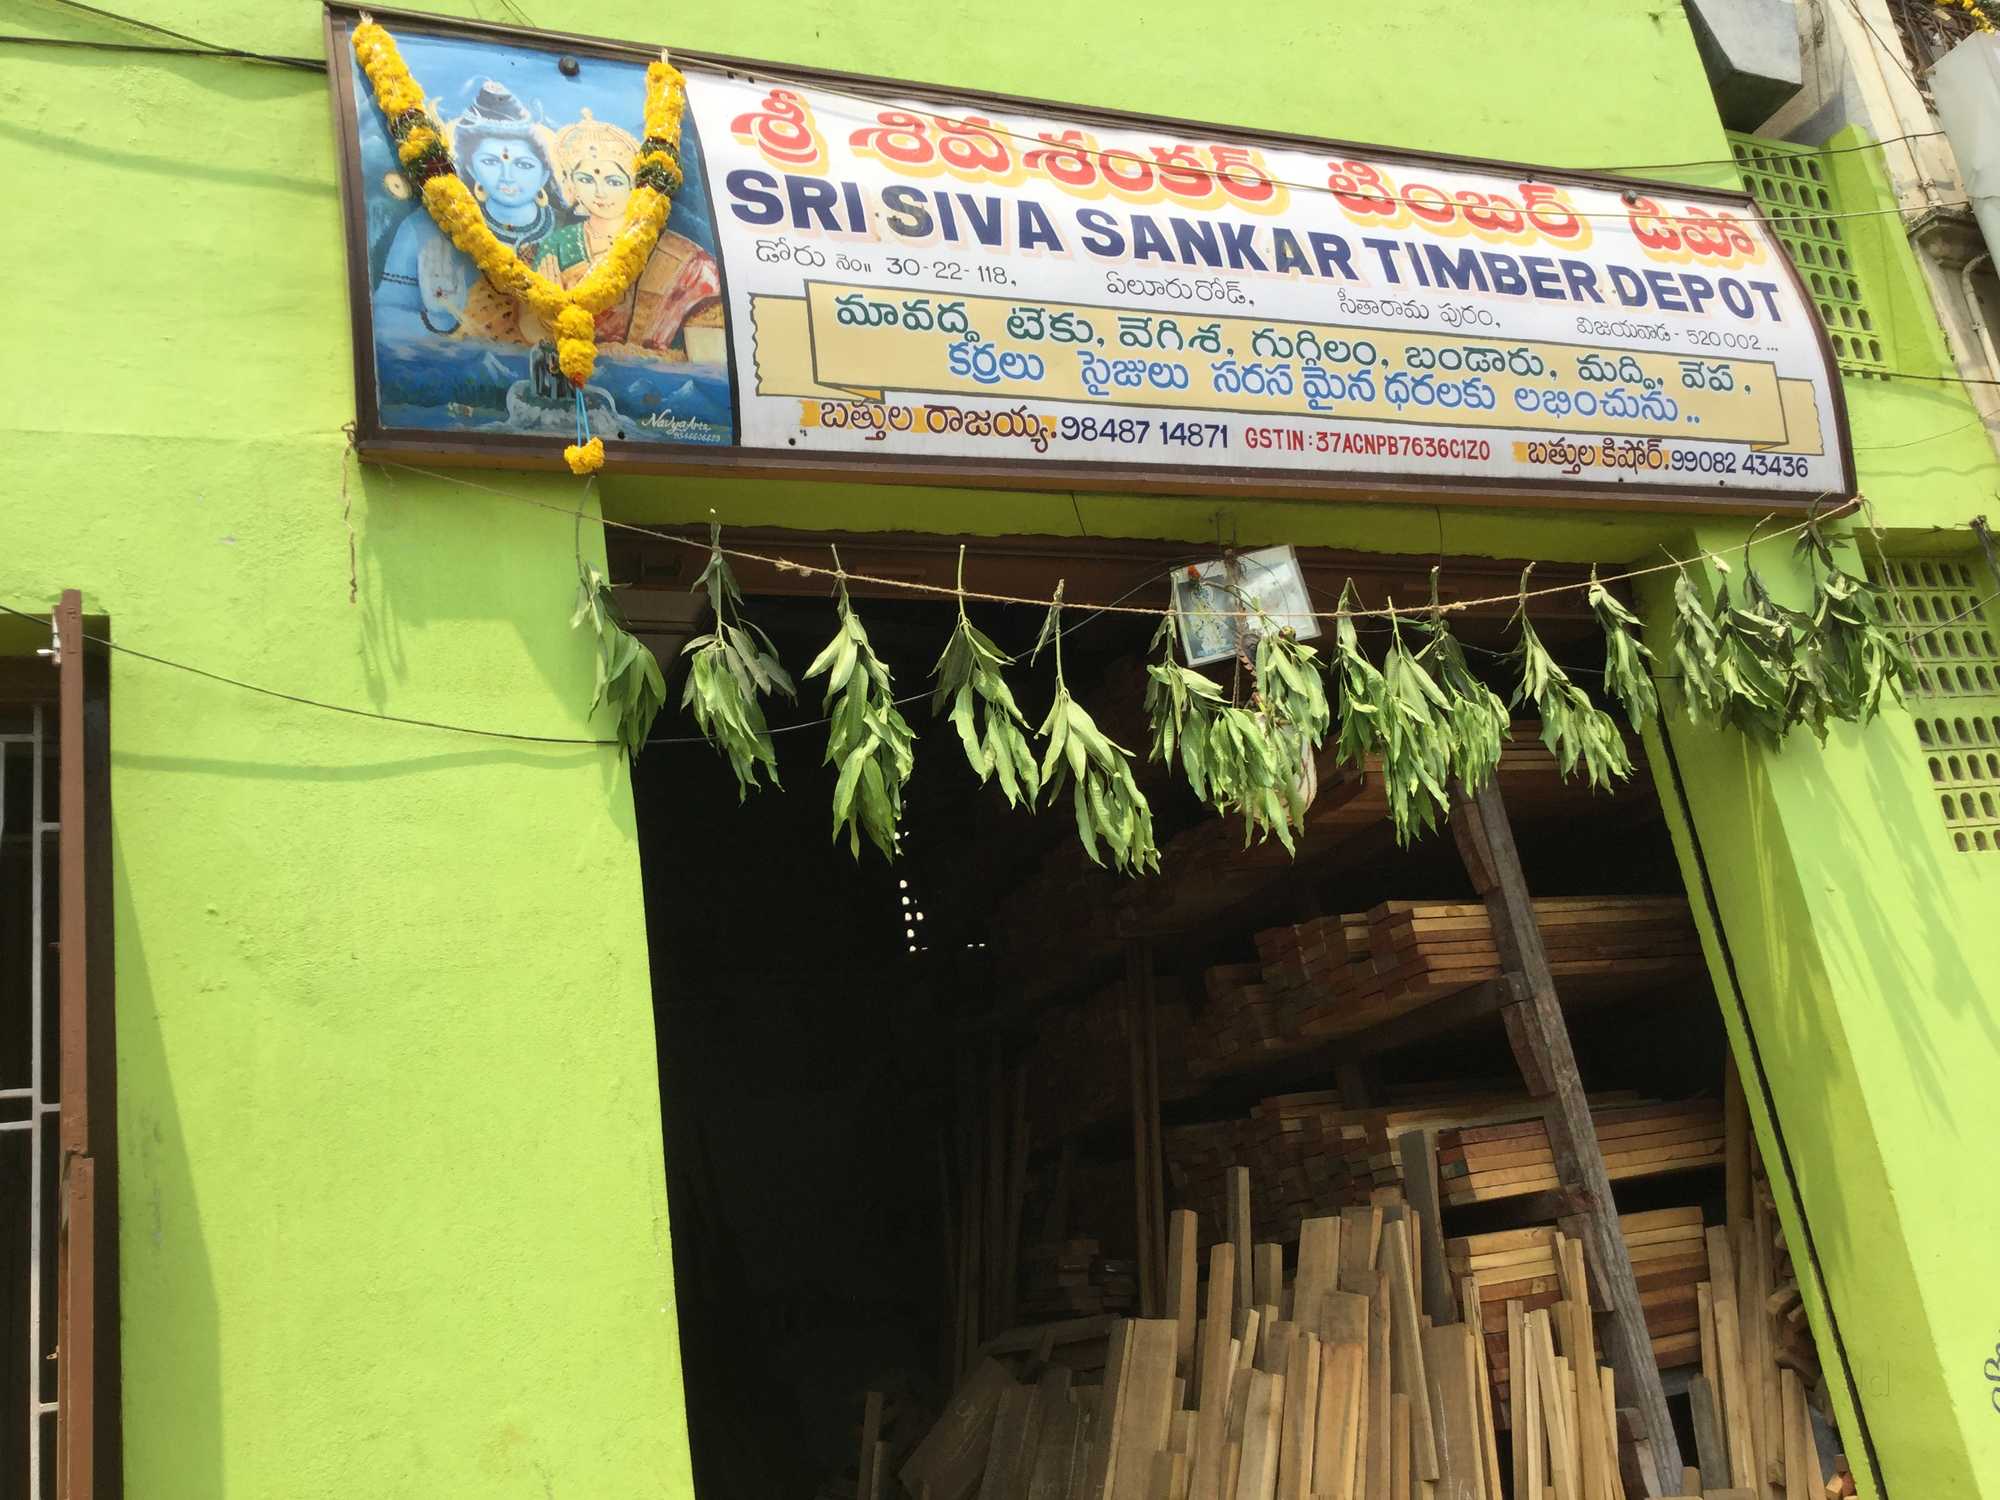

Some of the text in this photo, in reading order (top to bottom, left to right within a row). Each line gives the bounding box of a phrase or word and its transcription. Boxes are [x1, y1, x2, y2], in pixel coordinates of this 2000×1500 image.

[730, 88, 818, 167] శ్రీ
[849, 111, 1011, 173] శివ
[1023, 130, 1275, 203] శంకర్
[725, 169, 1783, 322] SRI SIVA SANKAR TIMBER DEPOT
[1061, 416, 1149, 443] 98487
[1160, 421, 1228, 448] 14871
[1671, 450, 1737, 474] 99082
[1743, 454, 1808, 477] 43436
